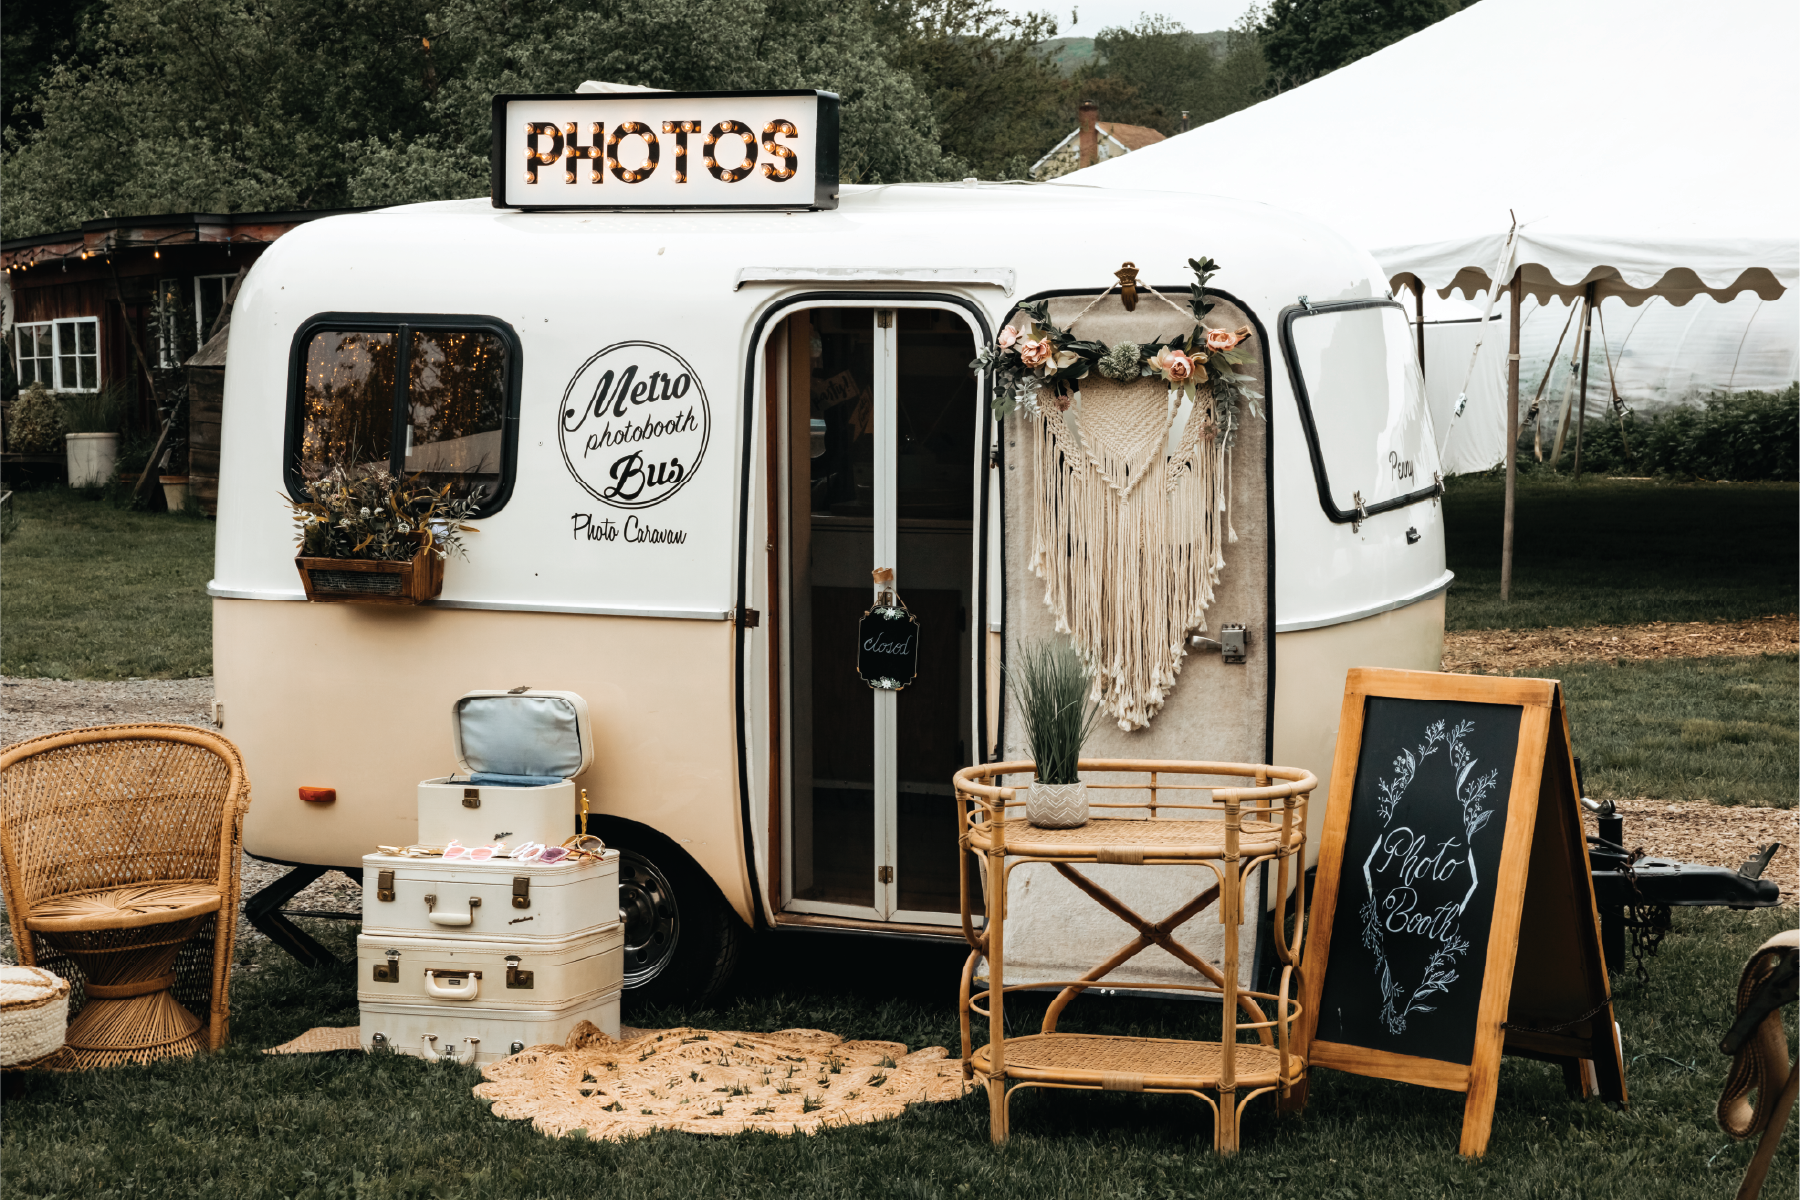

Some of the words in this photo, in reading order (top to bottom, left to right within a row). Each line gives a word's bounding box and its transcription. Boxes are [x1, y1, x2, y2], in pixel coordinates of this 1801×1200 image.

[524, 118, 799, 185] PHOTOS
[563, 364, 691, 433] Metro
[584, 405, 698, 459] photobooth
[604, 449, 684, 501] Bus
[1388, 450, 1415, 488] Penny
[571, 512, 619, 541] Photo
[623, 514, 687, 545] Caravan
[863, 631, 913, 656] closed
[1376, 826, 1465, 887] Photo
[1382, 886, 1460, 942] Booth
